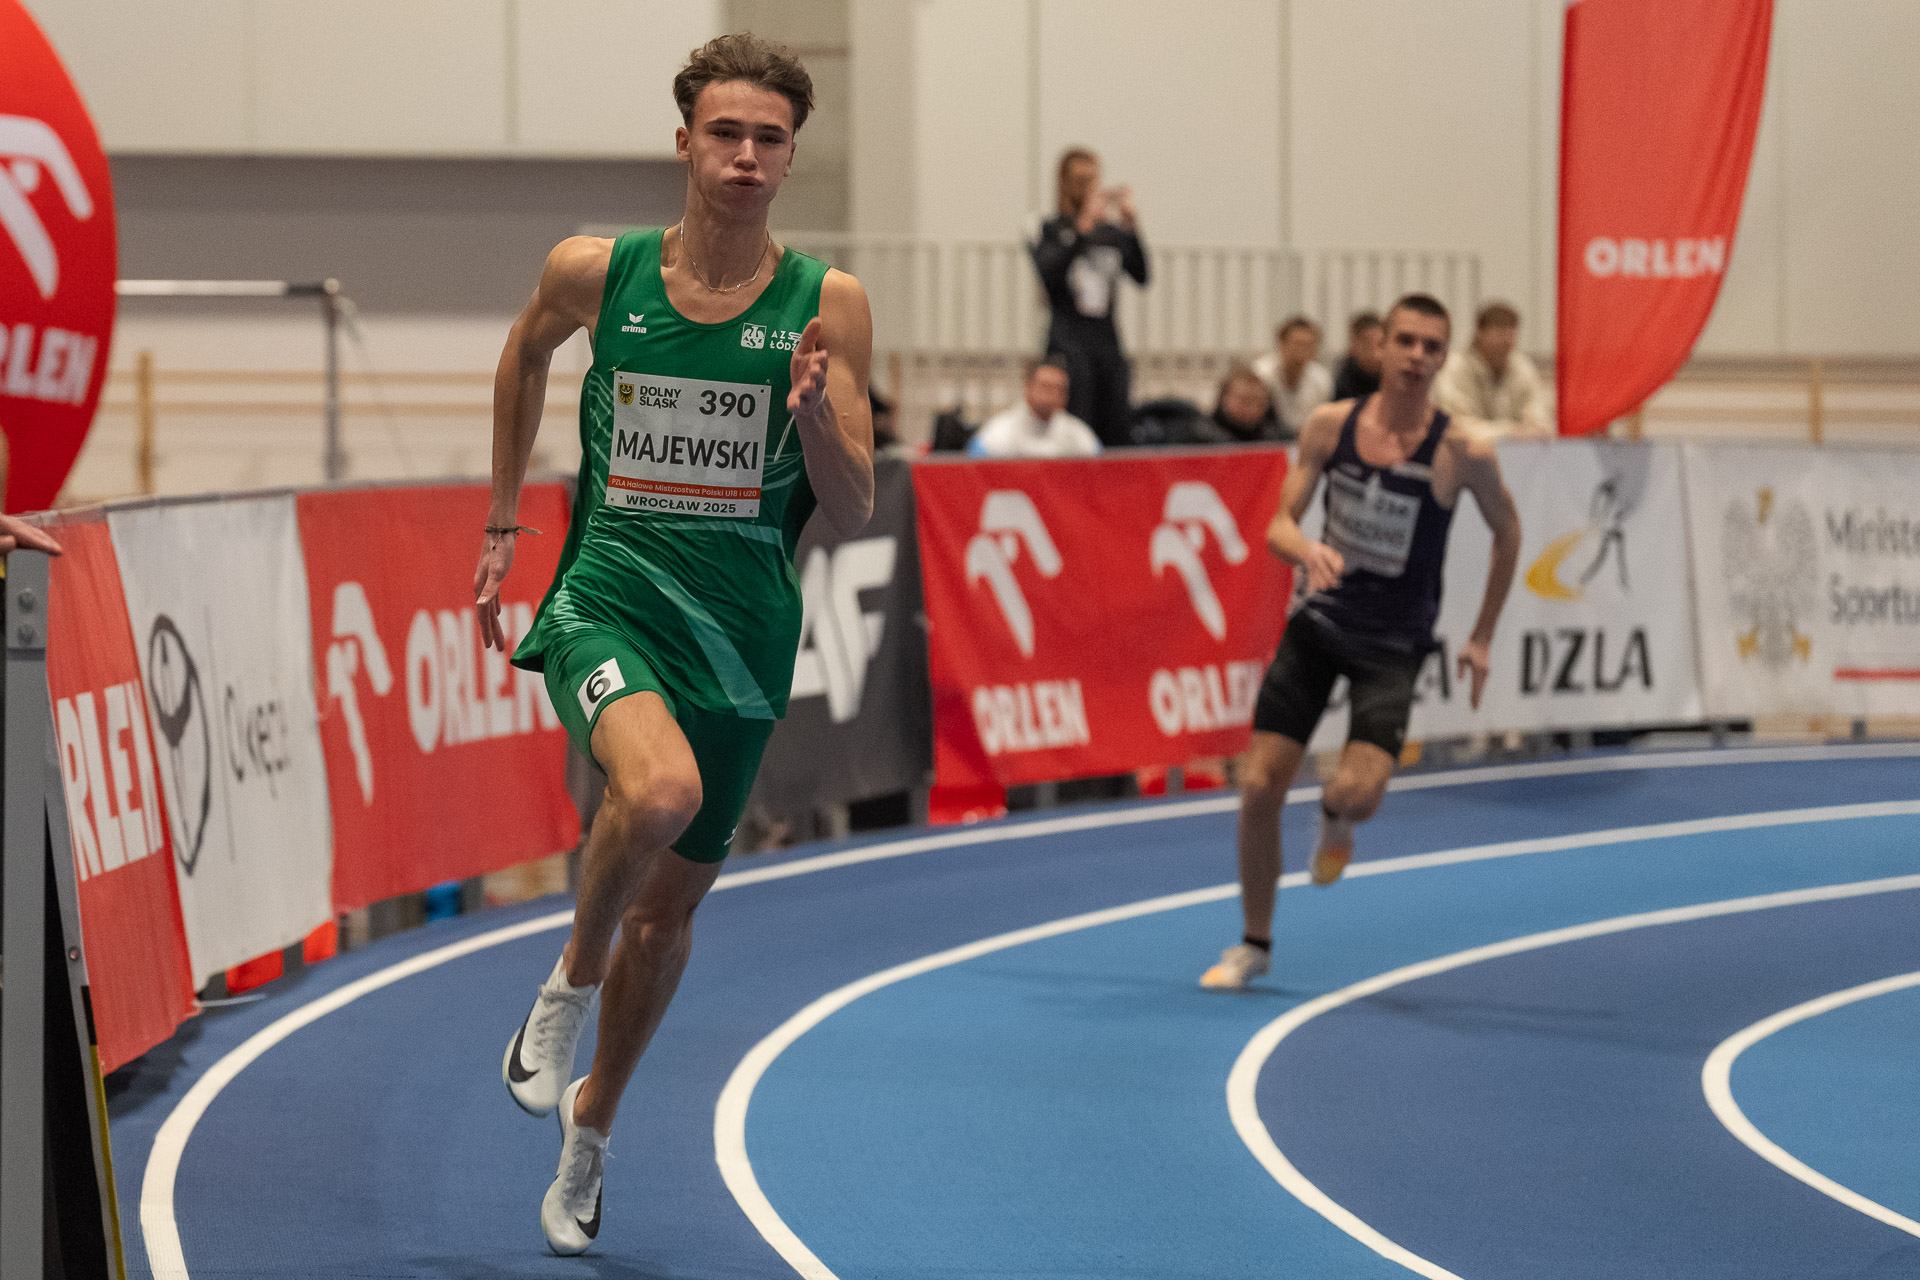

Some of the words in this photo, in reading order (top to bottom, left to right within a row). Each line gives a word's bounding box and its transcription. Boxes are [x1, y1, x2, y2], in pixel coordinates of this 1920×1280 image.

[1584, 235, 1726, 279] ORLEN
[621, 325, 647, 334] erima
[639, 385, 682, 399] DOLNY
[639, 395, 678, 410] ŚLĄSK
[699, 389, 756, 418] 390
[616, 429, 759, 470] MAJEWSKI
[611, 478, 626, 487] PZLA
[627, 481, 654, 490] Halowe
[655, 484, 700, 495] Mistrzostwa
[702, 488, 724, 496] Polski
[725, 489, 738, 497] U18
[625, 494, 700, 511] WROCŁAW
[703, 502, 737, 514] 2025
[1520, 624, 1653, 696] DZLA
[586, 669, 612, 704] 6
[973, 678, 1091, 757] ORLEN
